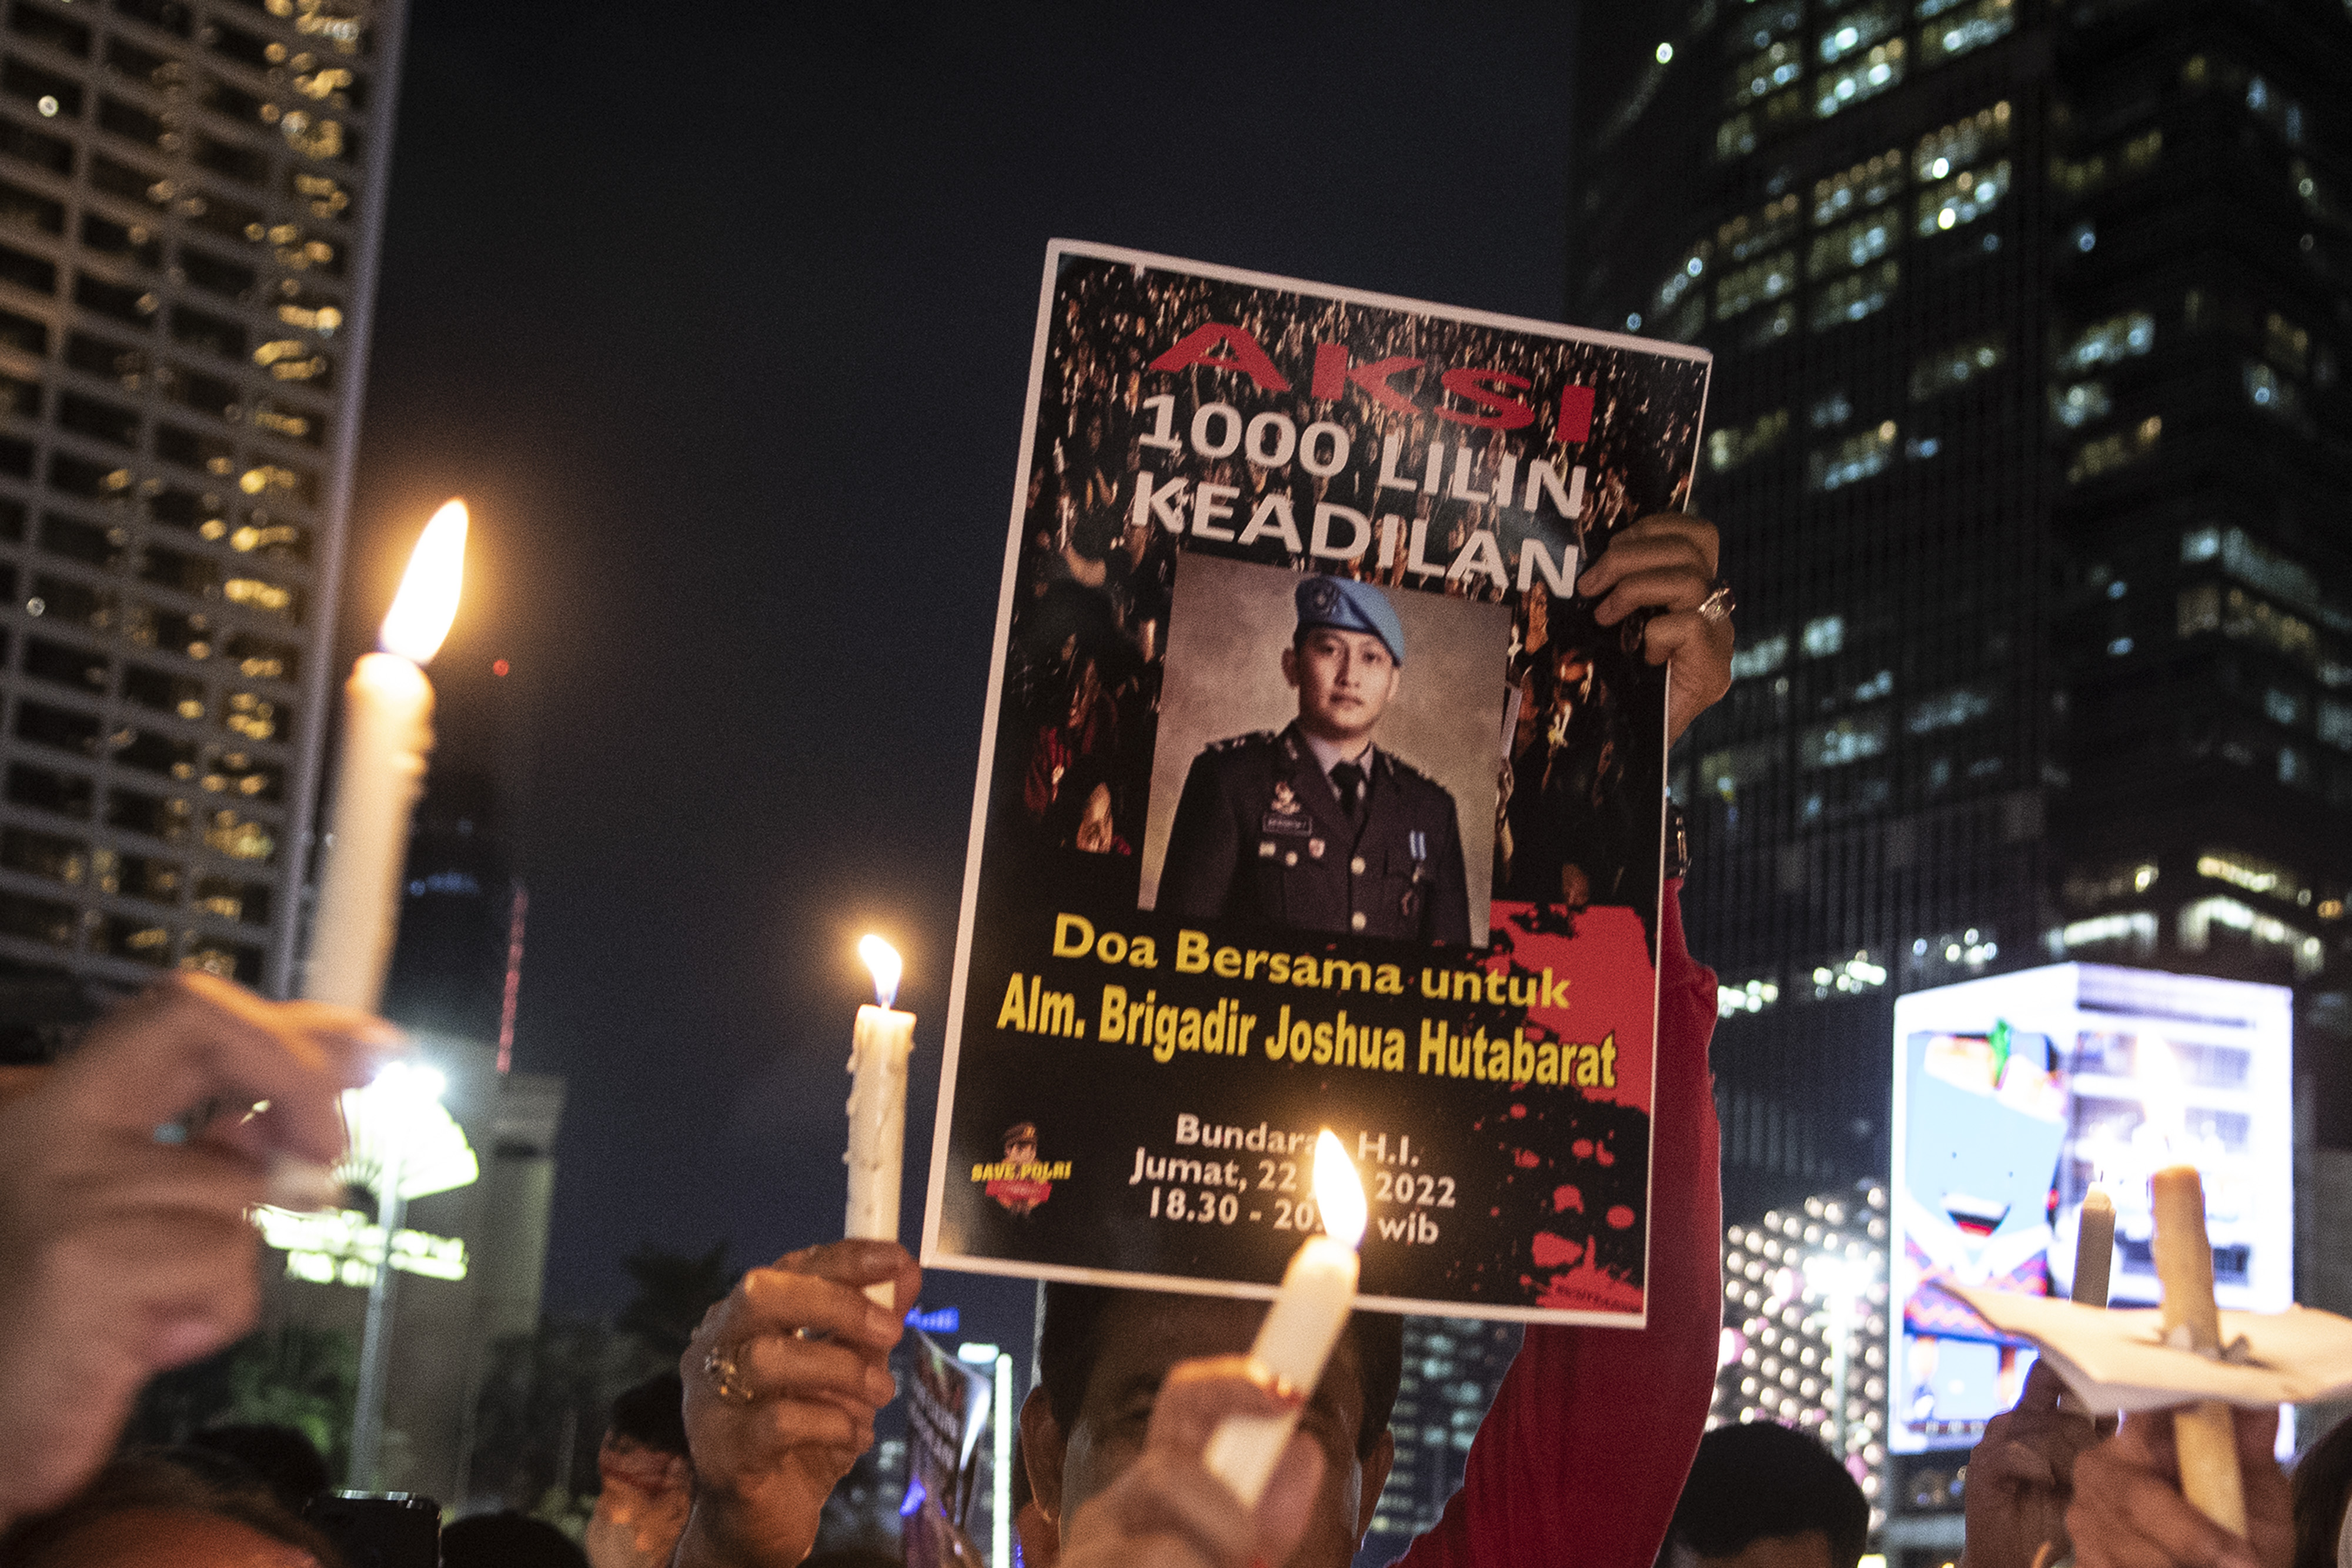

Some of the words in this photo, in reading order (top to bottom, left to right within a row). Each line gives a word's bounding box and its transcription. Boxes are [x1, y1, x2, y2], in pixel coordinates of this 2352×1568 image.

[1148, 322, 1595, 442] AKSI
[1138, 394, 1351, 477] 1000
[1378, 433, 1587, 520] LILIN
[1131, 471, 1578, 600] KEADILAN
[1053, 912, 1158, 969] Doa
[1175, 928, 1404, 995] Bersama
[1421, 967, 1572, 1009] untuk
[996, 972, 1085, 1039] Alm.
[1098, 984, 1257, 1064] Brigadir
[1265, 1004, 1406, 1072] Joshua
[1418, 1018, 1617, 1088] Hutabarat
[1128, 1146, 1247, 1193] Jumat,
[1257, 1159, 1297, 1192] 22
[1375, 1170, 1456, 1208] 2022
[1358, 1130, 1419, 1167] H.I.
[1150, 1186, 1238, 1225] 18.30
[1378, 1211, 1439, 1244] wib
